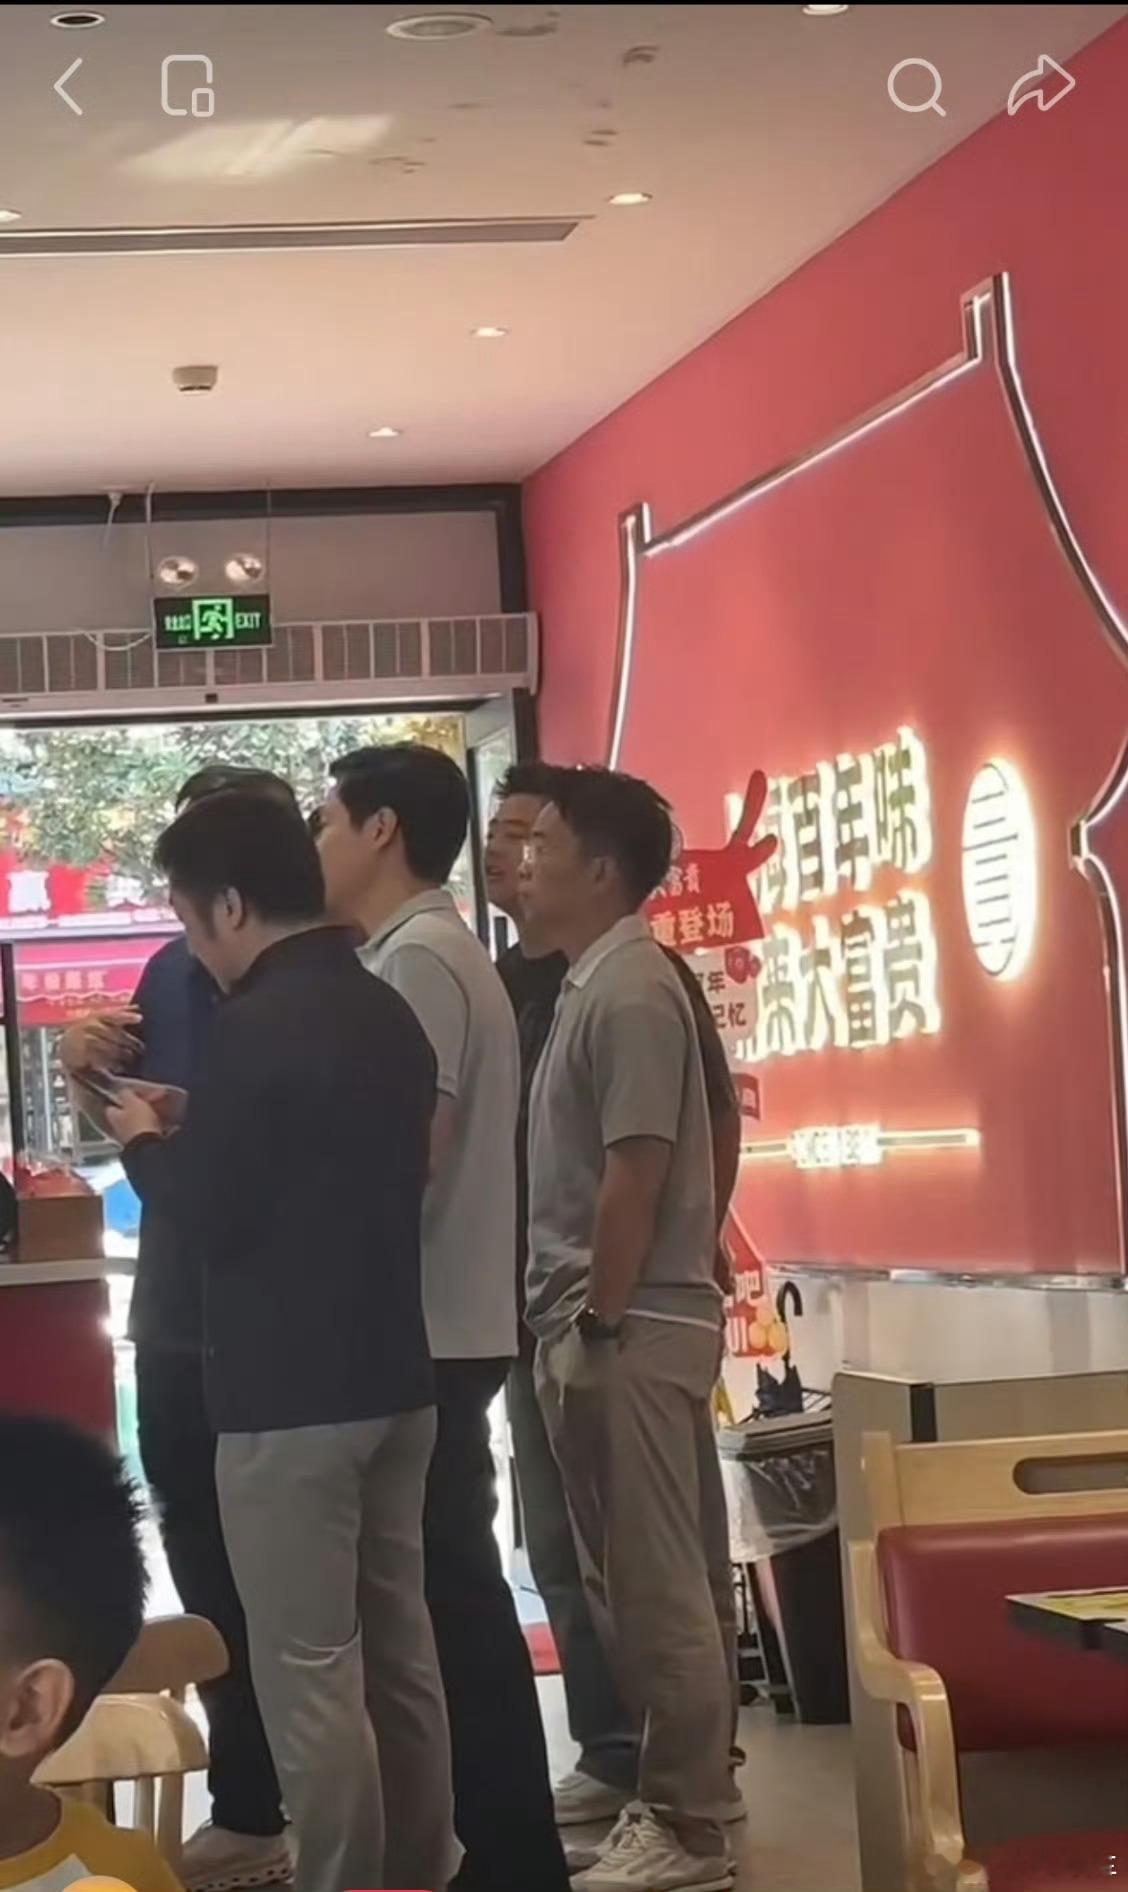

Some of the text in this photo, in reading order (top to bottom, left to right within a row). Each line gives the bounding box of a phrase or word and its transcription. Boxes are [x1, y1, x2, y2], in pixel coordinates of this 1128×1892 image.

[234, 611, 262, 630] EXIT
[735, 888, 941, 1064] 来大富贵
